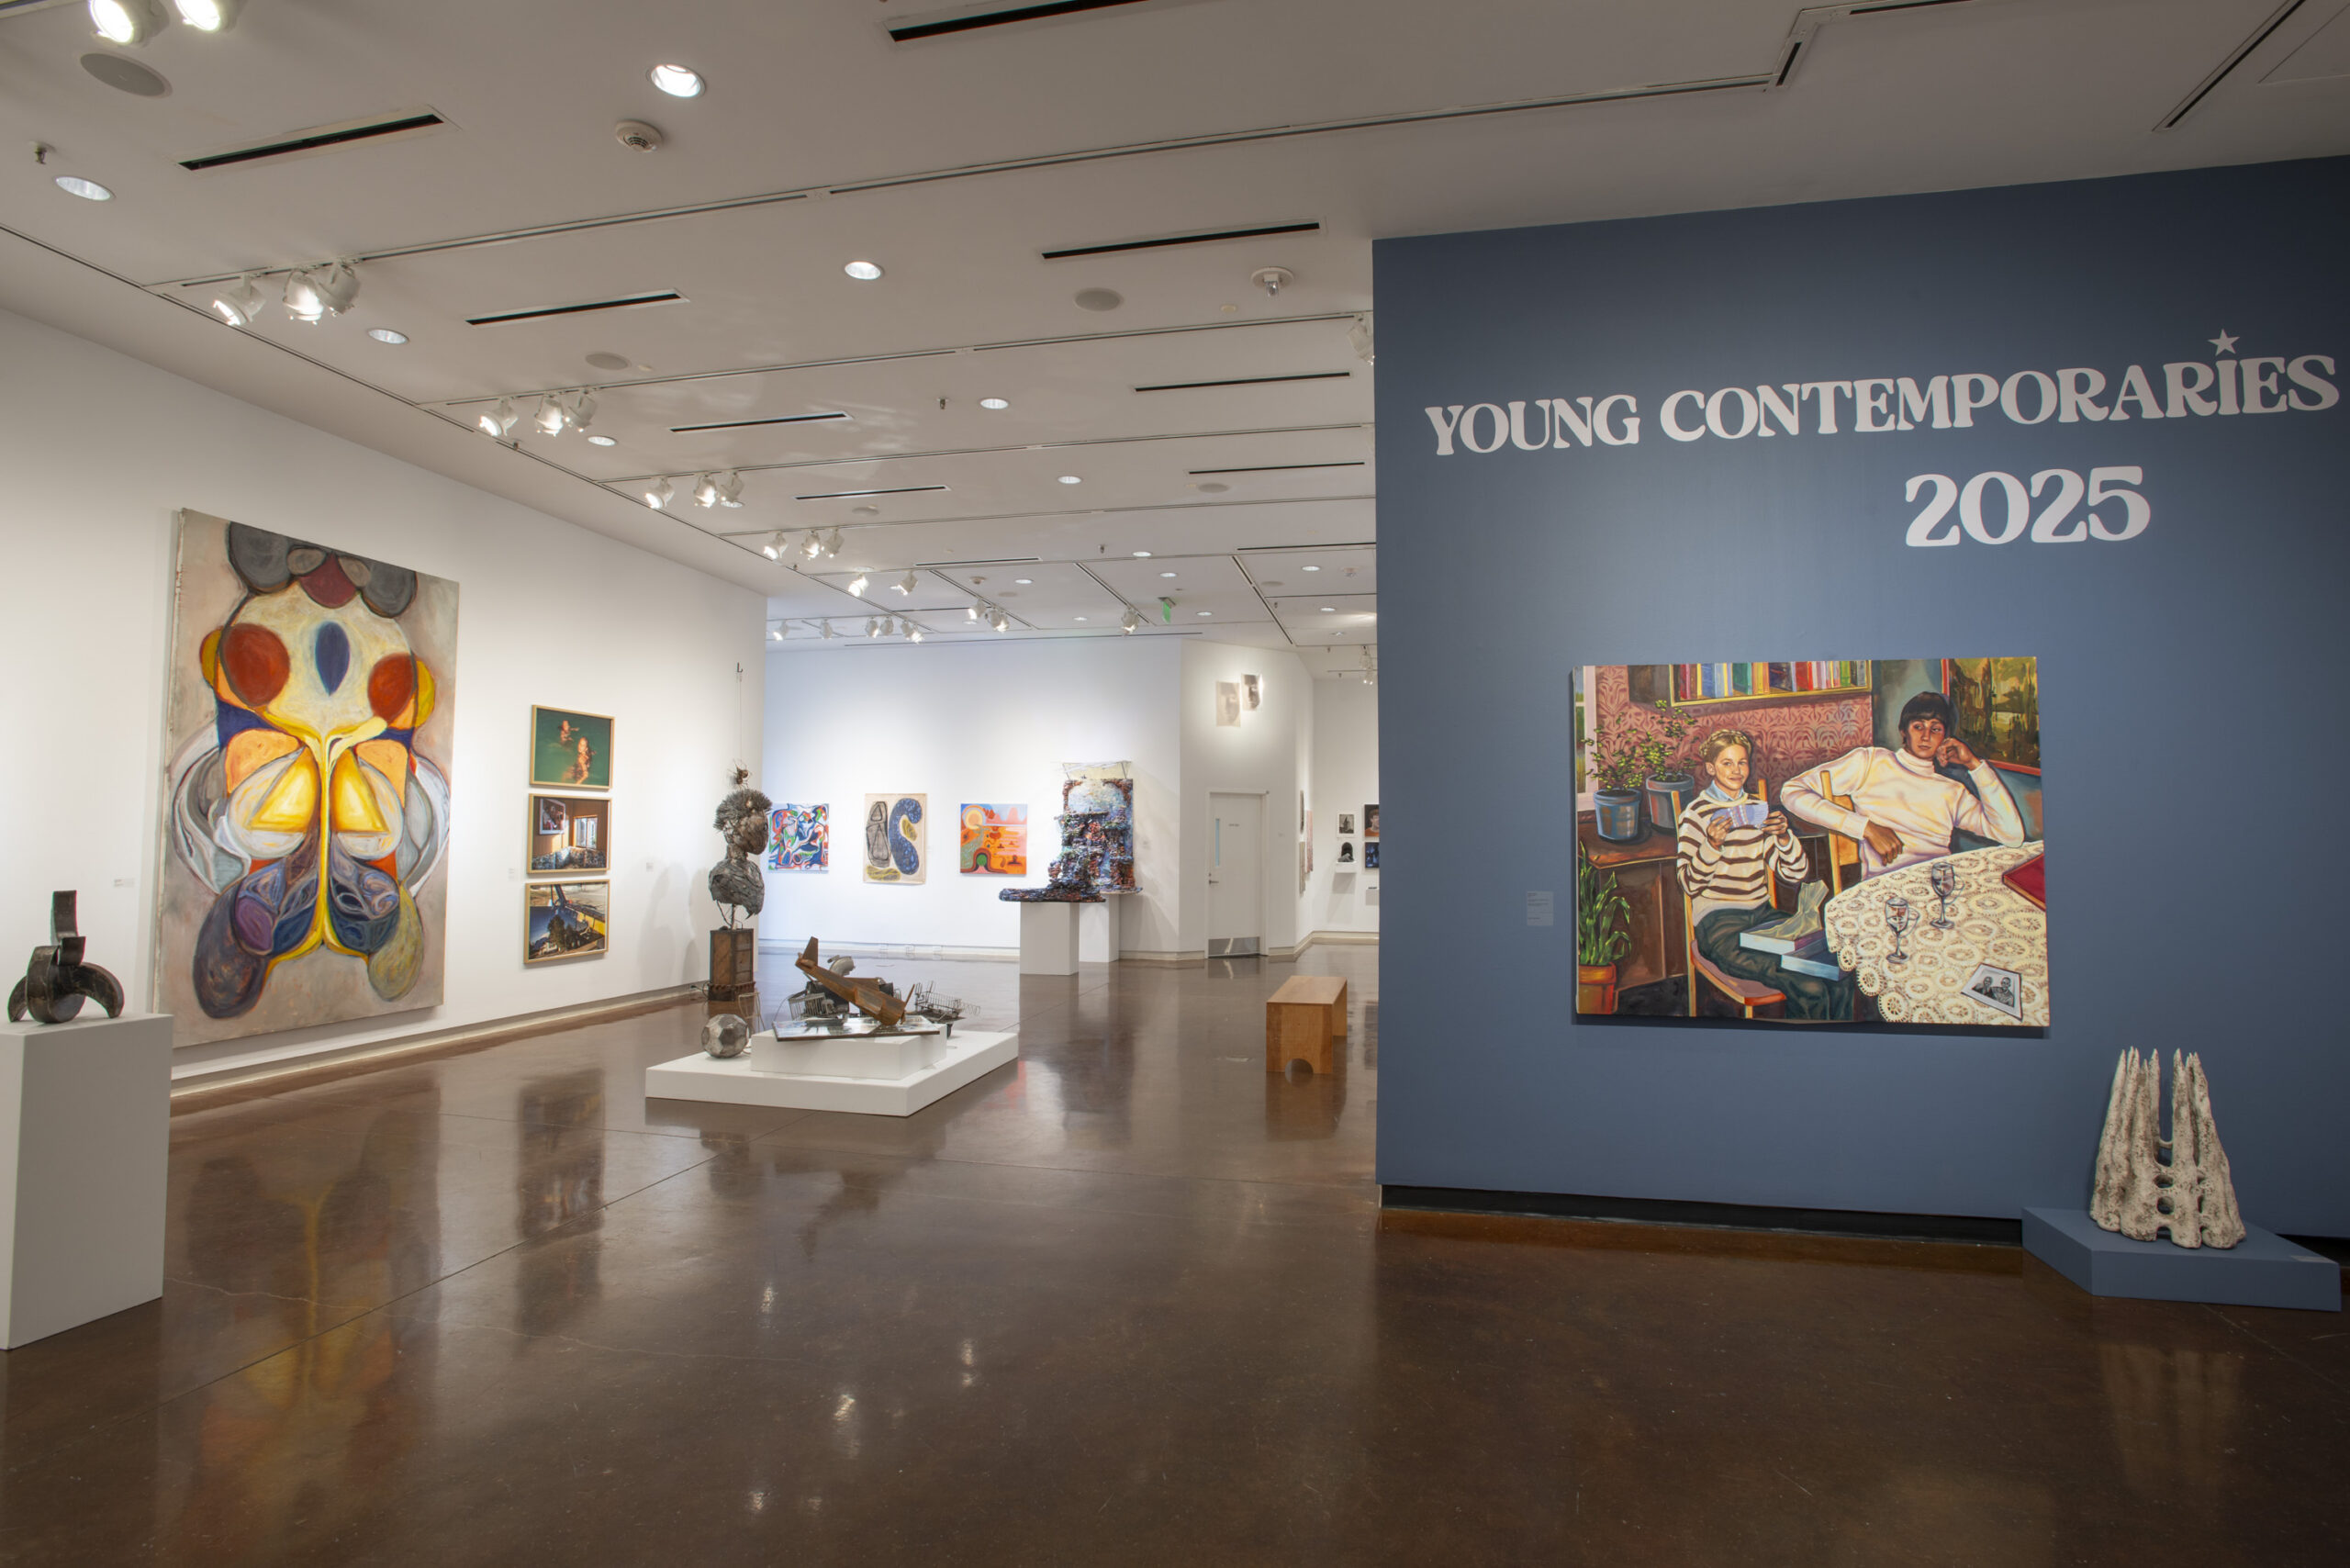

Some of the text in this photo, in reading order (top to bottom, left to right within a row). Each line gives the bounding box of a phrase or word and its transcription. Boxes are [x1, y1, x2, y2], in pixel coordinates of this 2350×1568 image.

[1425, 329, 2340, 455] YOUNG CONTEMPORARIES
[1905, 466, 2151, 547] 2025
